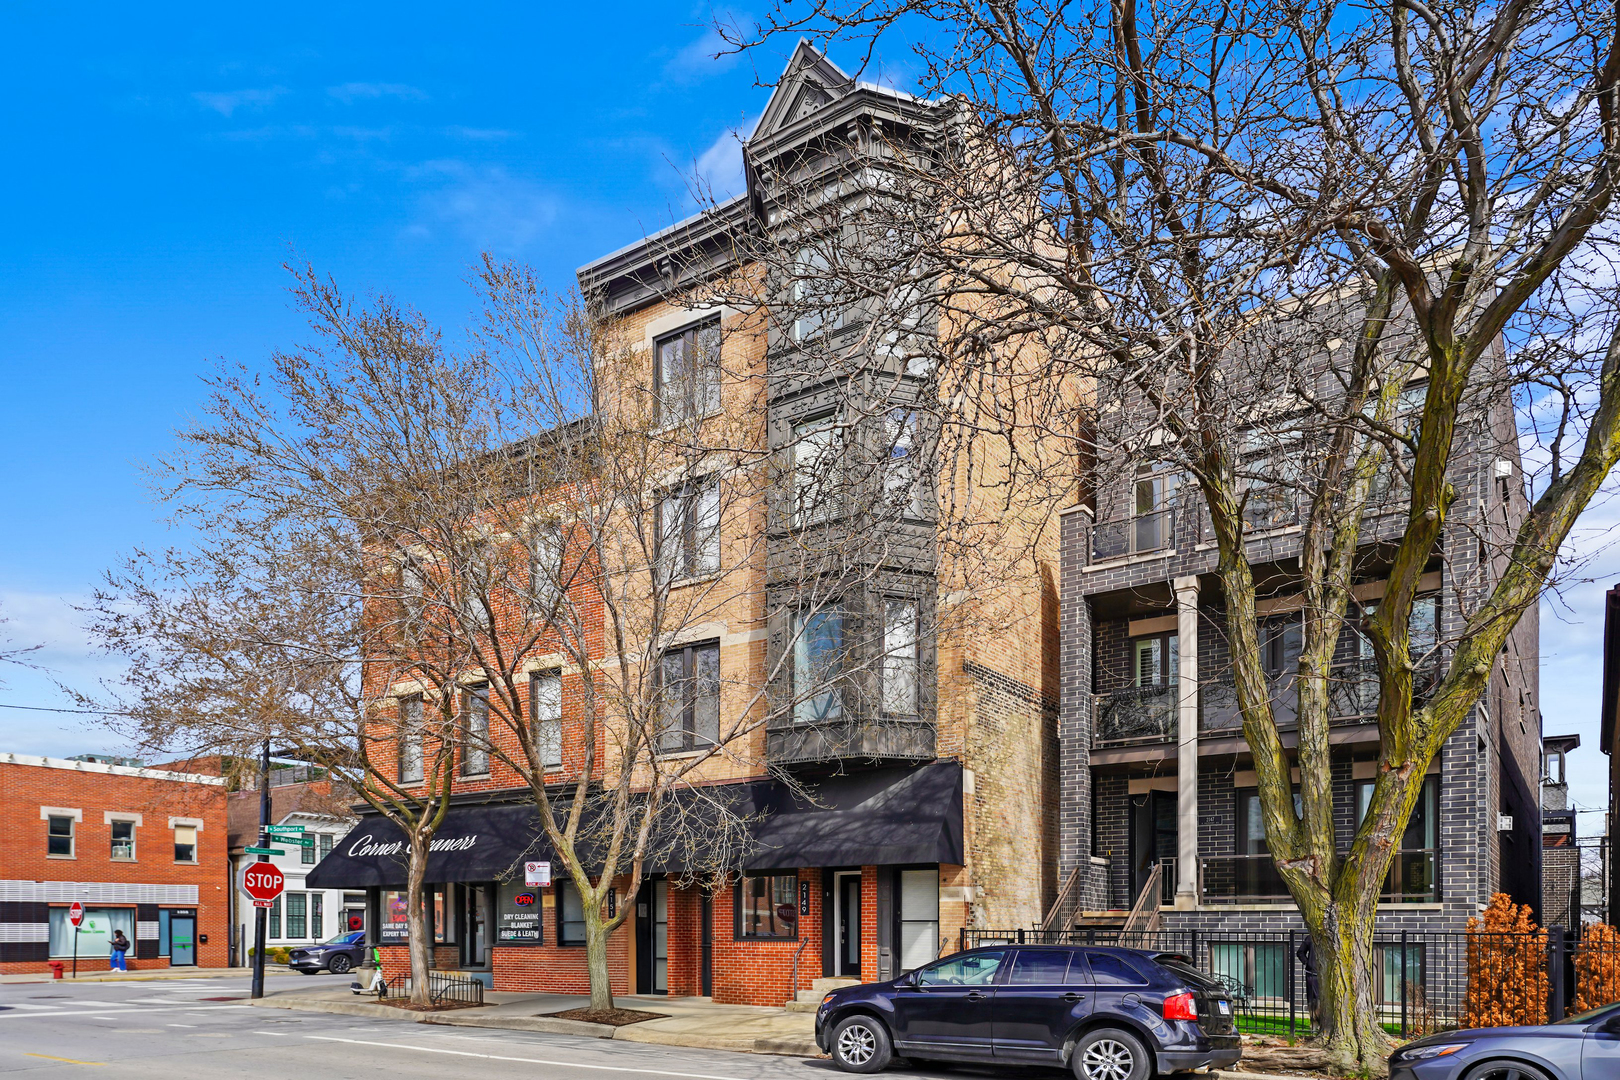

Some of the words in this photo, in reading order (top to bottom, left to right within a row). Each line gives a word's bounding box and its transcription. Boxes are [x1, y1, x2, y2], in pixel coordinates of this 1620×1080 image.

[273, 825, 298, 833] Southport
[280, 836, 303, 845] Webster
[348, 834, 402, 857] Corner
[246, 873, 282, 889] STOP
[514, 895, 534, 904] OPEN
[70, 909, 82, 918] STOP
